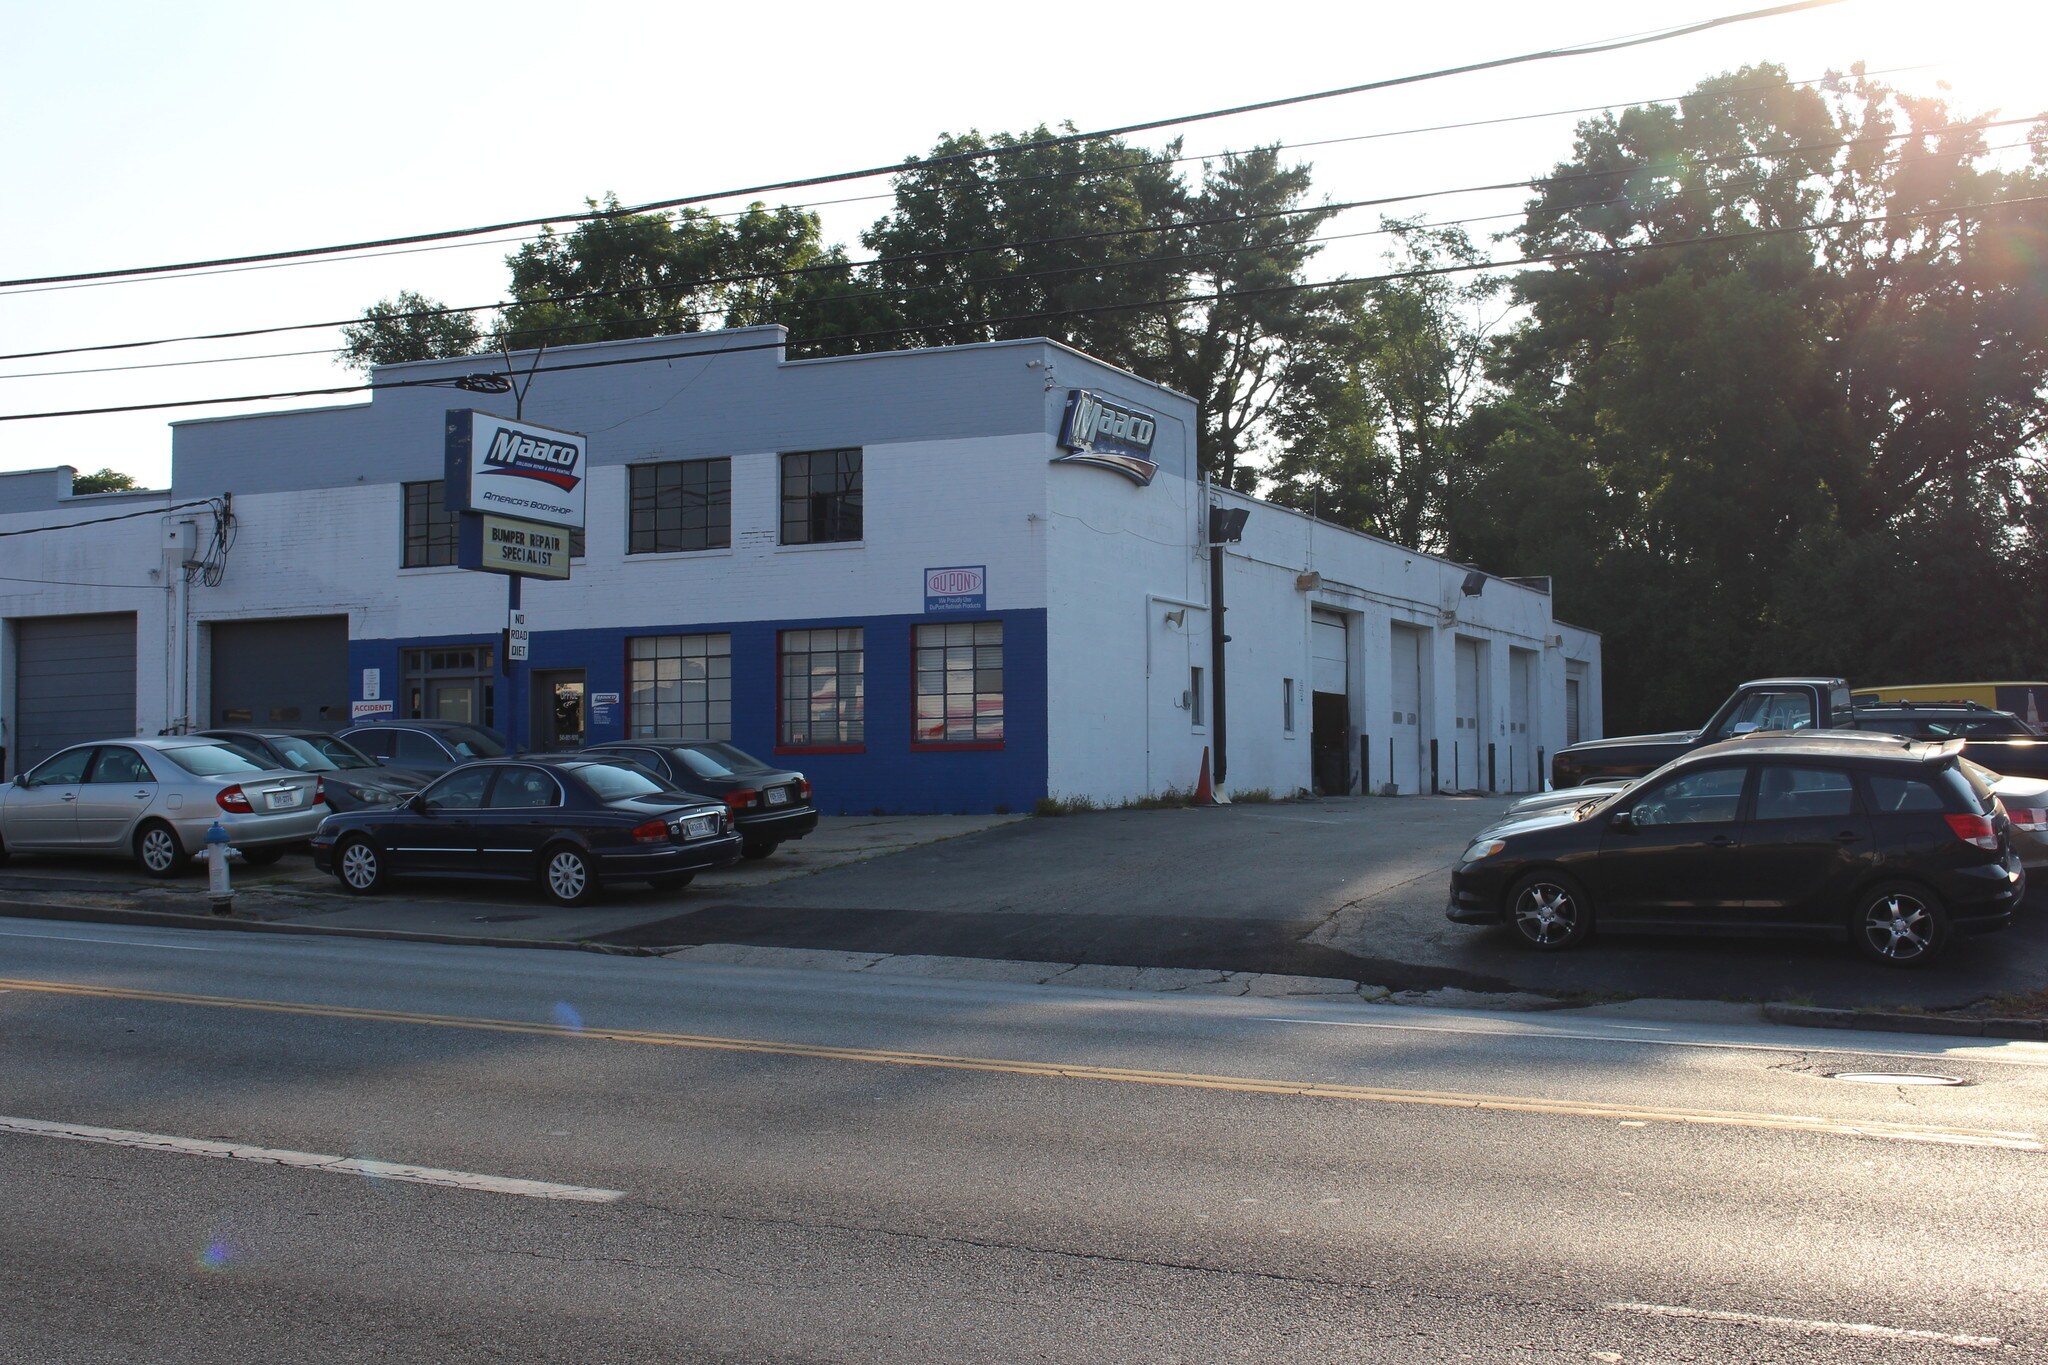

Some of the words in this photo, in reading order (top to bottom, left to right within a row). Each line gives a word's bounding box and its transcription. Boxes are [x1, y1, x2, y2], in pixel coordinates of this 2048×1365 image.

[1072, 398, 1154, 445] Maaco
[489, 431, 576, 466] Maaco
[492, 527, 525, 546] BUMPER
[530, 533, 560, 551] REPAIR
[502, 545, 552, 566] SPECIALIST
[515, 614, 525, 625] NO
[511, 629, 528, 641] ROAD
[511, 645, 526, 657] DIET
[354, 704, 392, 712] ACCIDENT?
